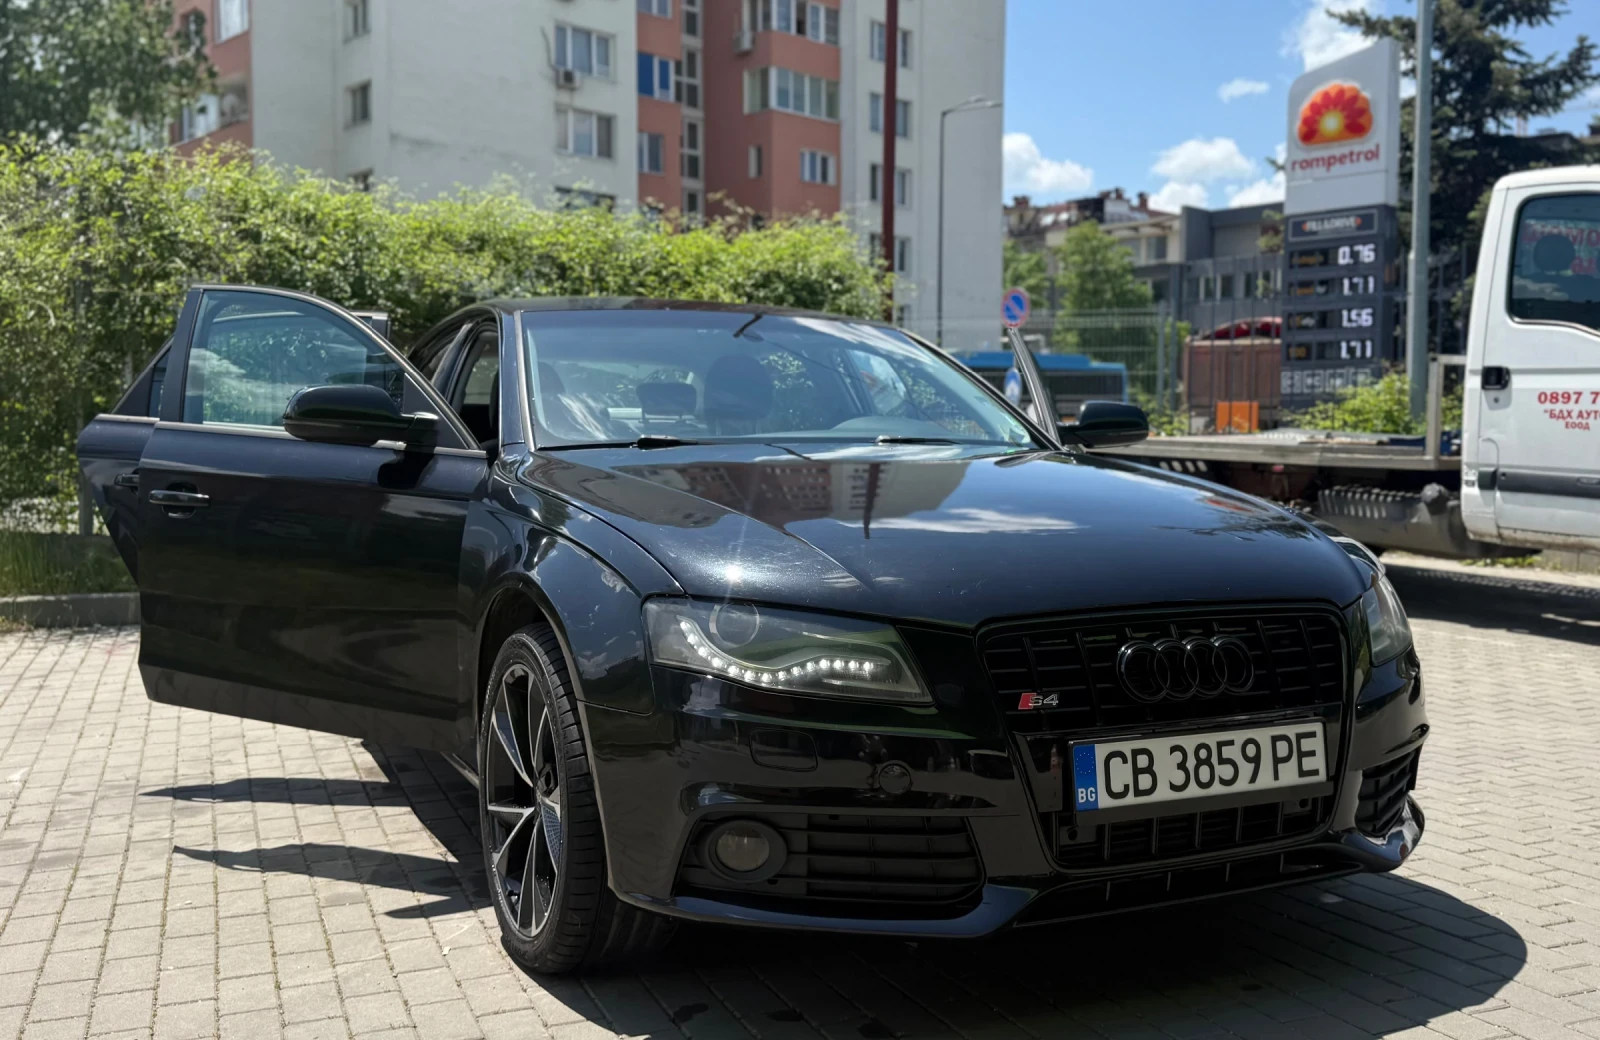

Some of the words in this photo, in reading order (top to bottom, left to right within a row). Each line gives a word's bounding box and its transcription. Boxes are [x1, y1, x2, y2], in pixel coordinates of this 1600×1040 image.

[1291, 144, 1380, 172] rompetrol
[1342, 275, 1375, 296] 1.71
[1340, 340, 1372, 359] 1.71
[1537, 391, 1583, 405] 0897
[1576, 410, 1600, 421] АУТ
[1565, 421, 1590, 430] ЕООД
[1028, 693, 1059, 707] S4
[1103, 748, 1158, 799] CB
[1169, 737, 1262, 792] 3859
[1270, 731, 1320, 781] PE
[1077, 787, 1097, 803] BG
